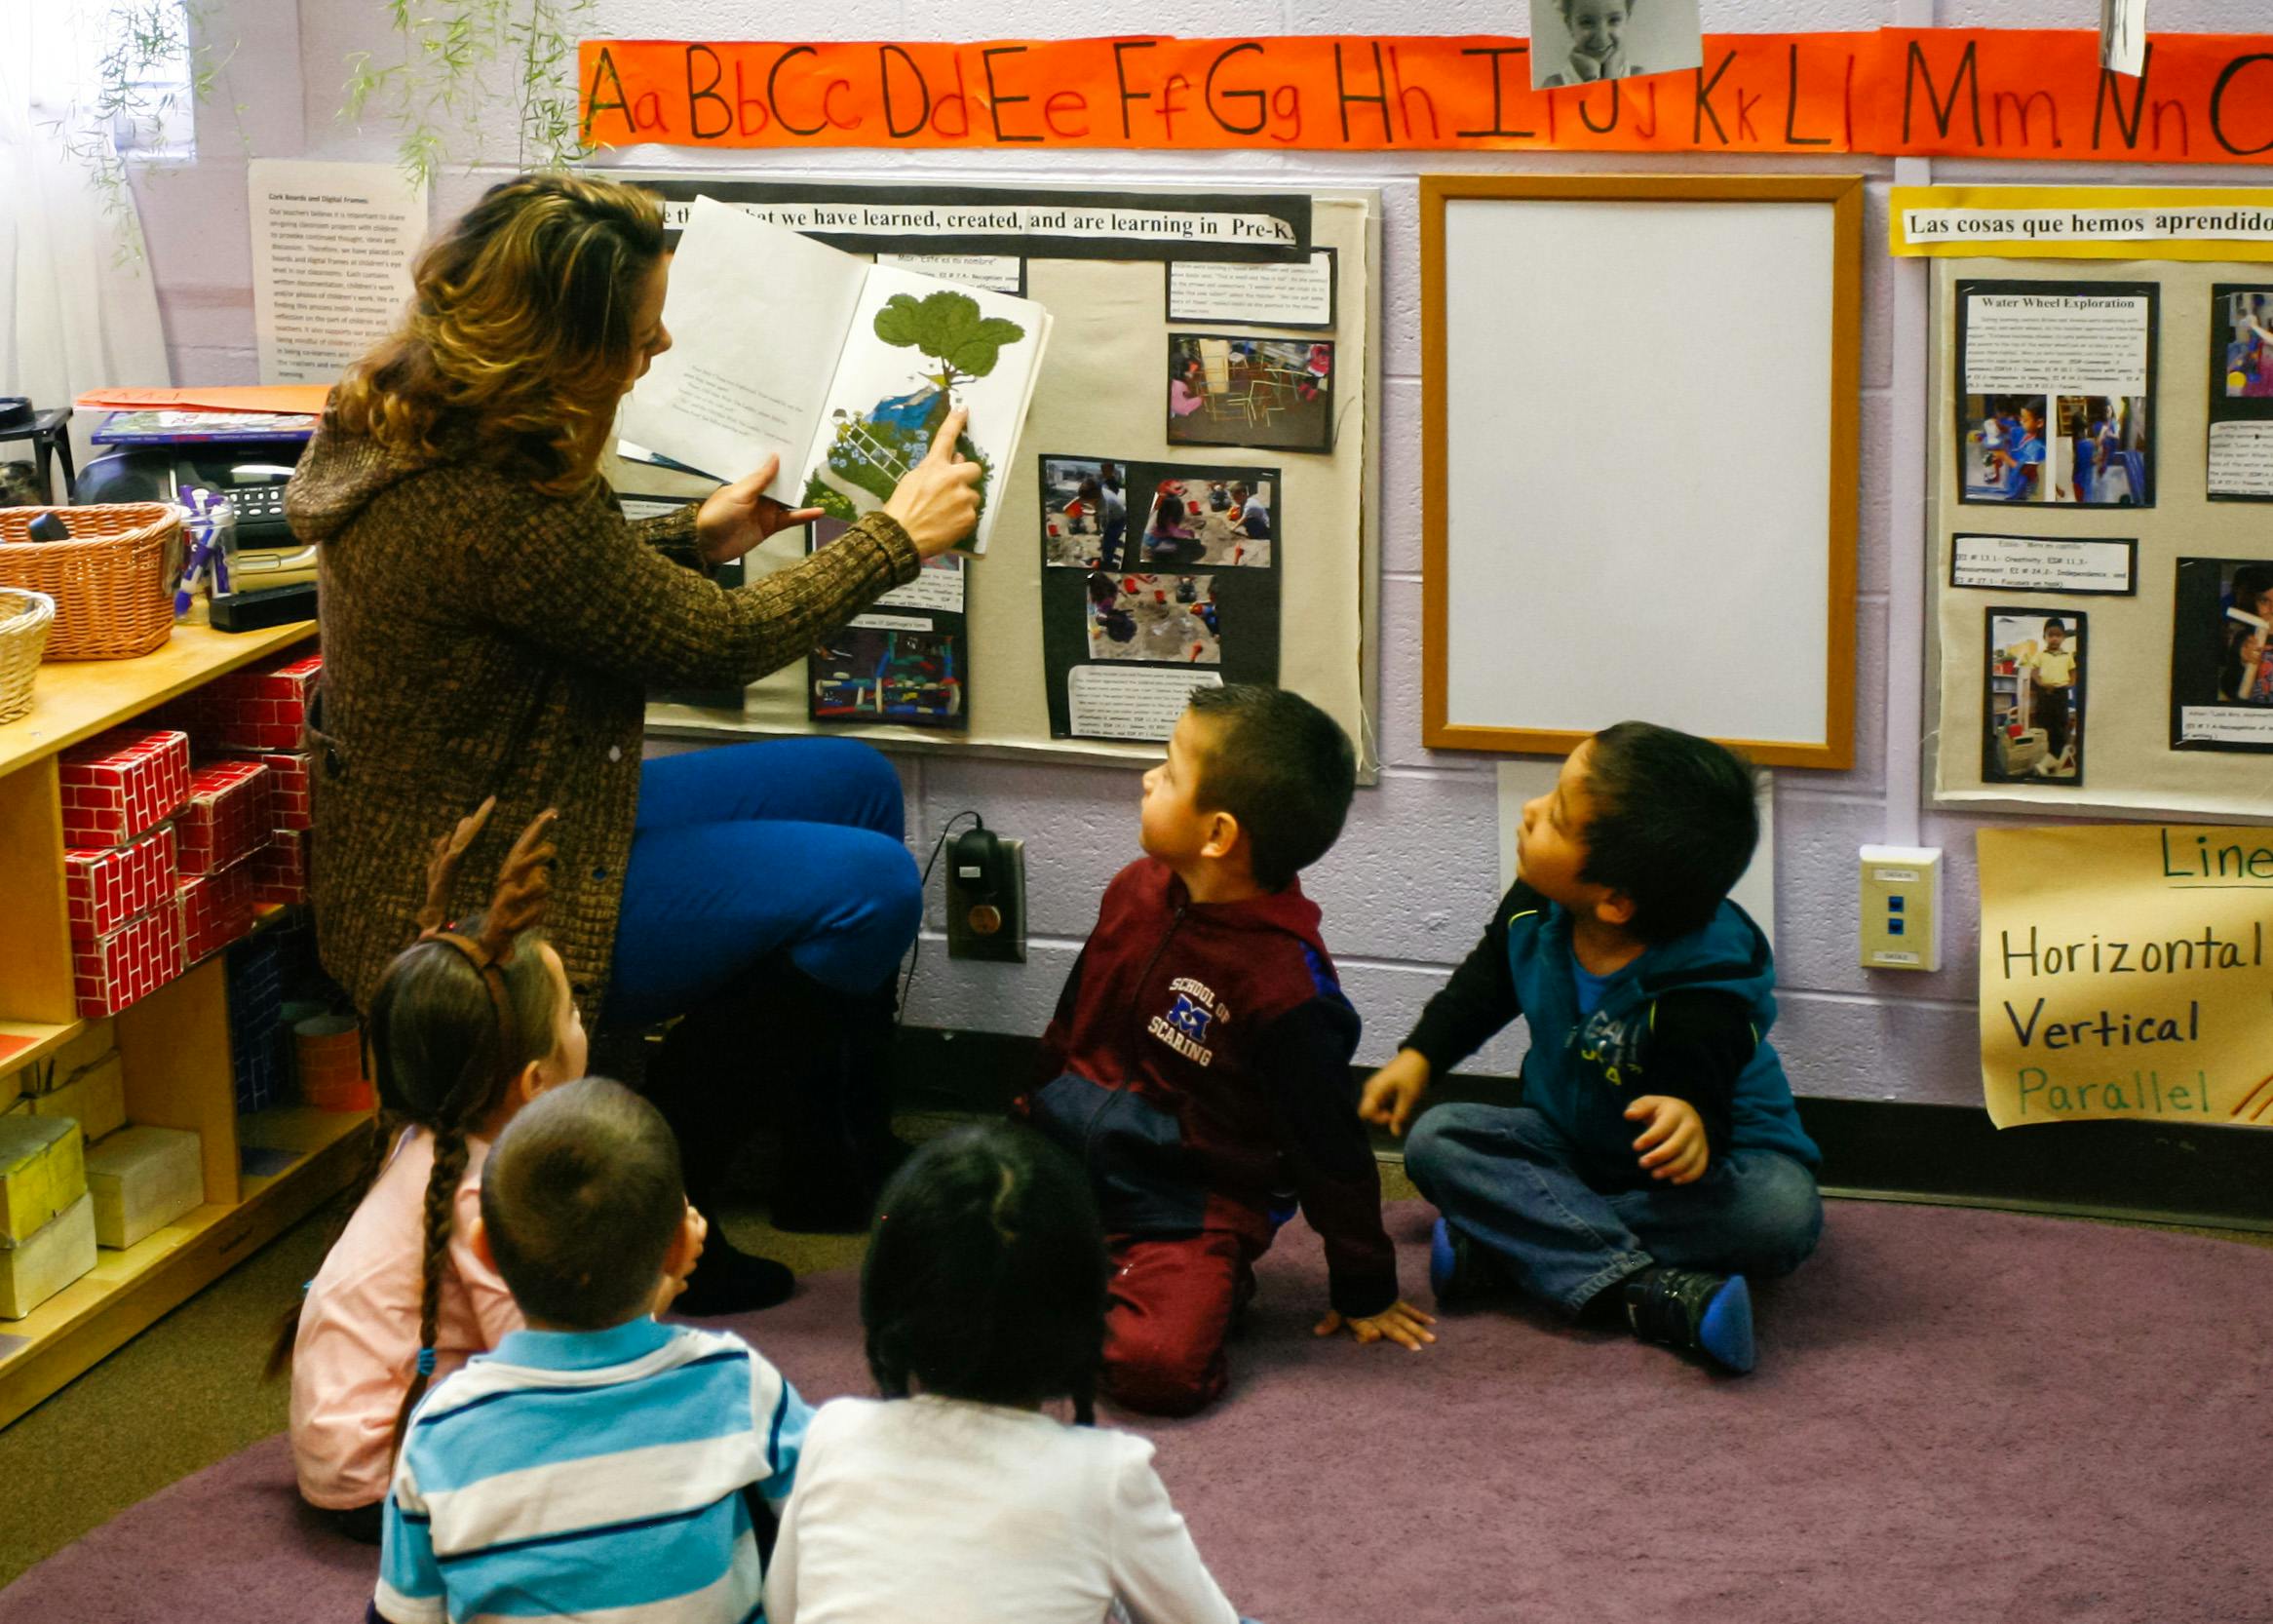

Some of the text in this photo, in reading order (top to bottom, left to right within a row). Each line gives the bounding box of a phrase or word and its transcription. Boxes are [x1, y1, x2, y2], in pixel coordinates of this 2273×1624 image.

[782, 213, 807, 225] we
[813, 208, 858, 226] have
[864, 208, 941, 229] learned,
[947, 211, 1022, 231] created,
[1030, 212, 1066, 229] and
[1073, 215, 1105, 230] are
[1111, 213, 1193, 238] learning
[1200, 216, 1217, 234] in
[1909, 214, 1949, 234] Las
[1956, 218, 2015, 234] cosas
[2023, 217, 2063, 238] que
[2072, 213, 2144, 233] hemos
[1983, 296, 2136, 311] Water Wheel Exploration
[2001, 921, 2261, 980] Horizontal
[1169, 977, 1215, 1009] SCHOOL
[1147, 1015, 1214, 1067] SCARING
[2003, 997, 2199, 1050] Vertical
[2017, 1066, 2211, 1115] Parallel
